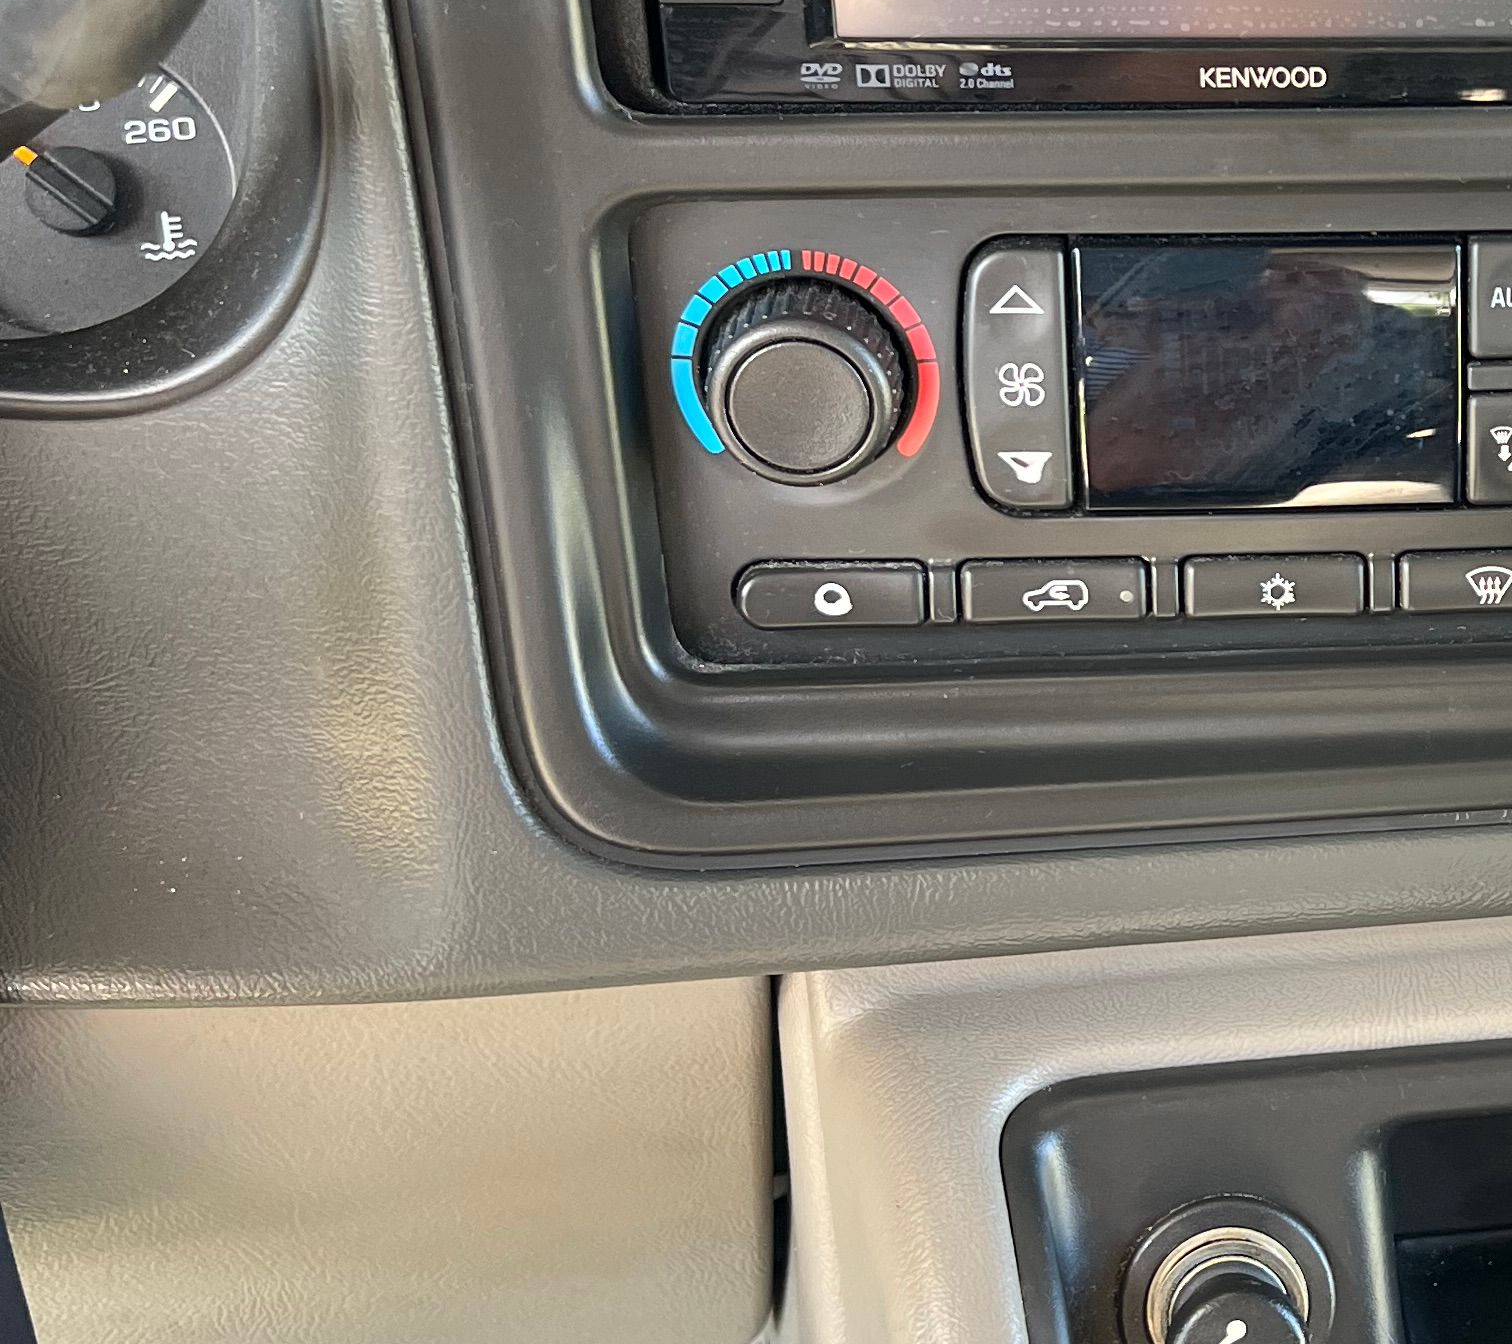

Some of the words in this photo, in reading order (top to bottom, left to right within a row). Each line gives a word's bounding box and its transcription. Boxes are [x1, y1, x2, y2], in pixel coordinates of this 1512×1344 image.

[801, 63, 843, 76] DVD
[893, 64, 946, 77] DOLBY
[981, 62, 1012, 77] dts
[894, 78, 939, 88] DIGITAL
[960, 79, 974, 89] 2.0
[976, 78, 1014, 89] Channel
[1200, 66, 1327, 88] KENWOOD
[124, 117, 197, 145] 260
